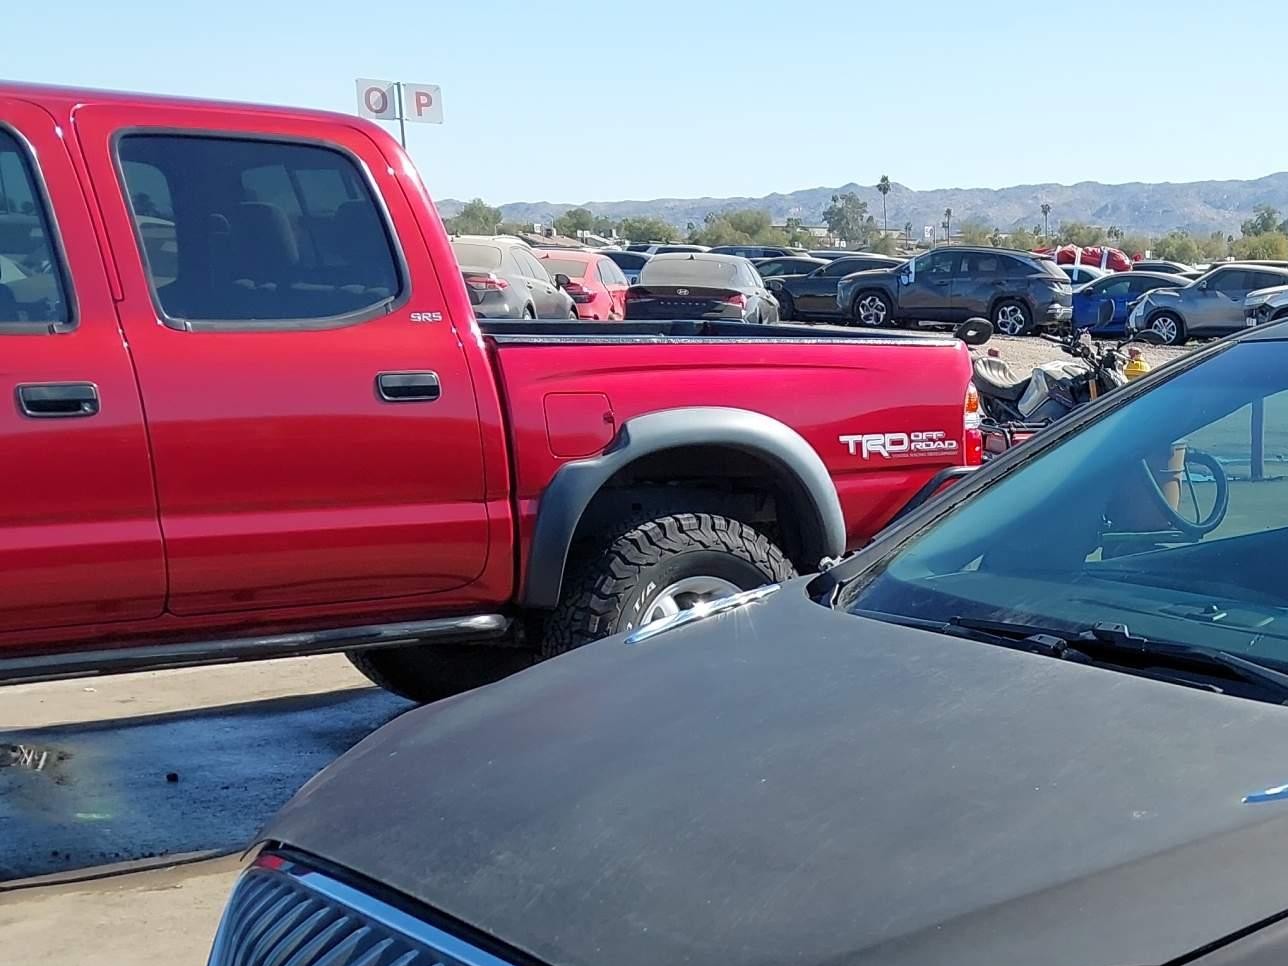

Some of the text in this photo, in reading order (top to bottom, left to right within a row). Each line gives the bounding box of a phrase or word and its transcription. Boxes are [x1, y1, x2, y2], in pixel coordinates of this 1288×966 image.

[364, 86, 388, 114] O
[415, 91, 433, 116] P
[410, 312, 443, 322] SR5
[910, 431, 945, 440] OFF
[838, 432, 909, 460] TRD
[910, 441, 957, 450] ROAD
